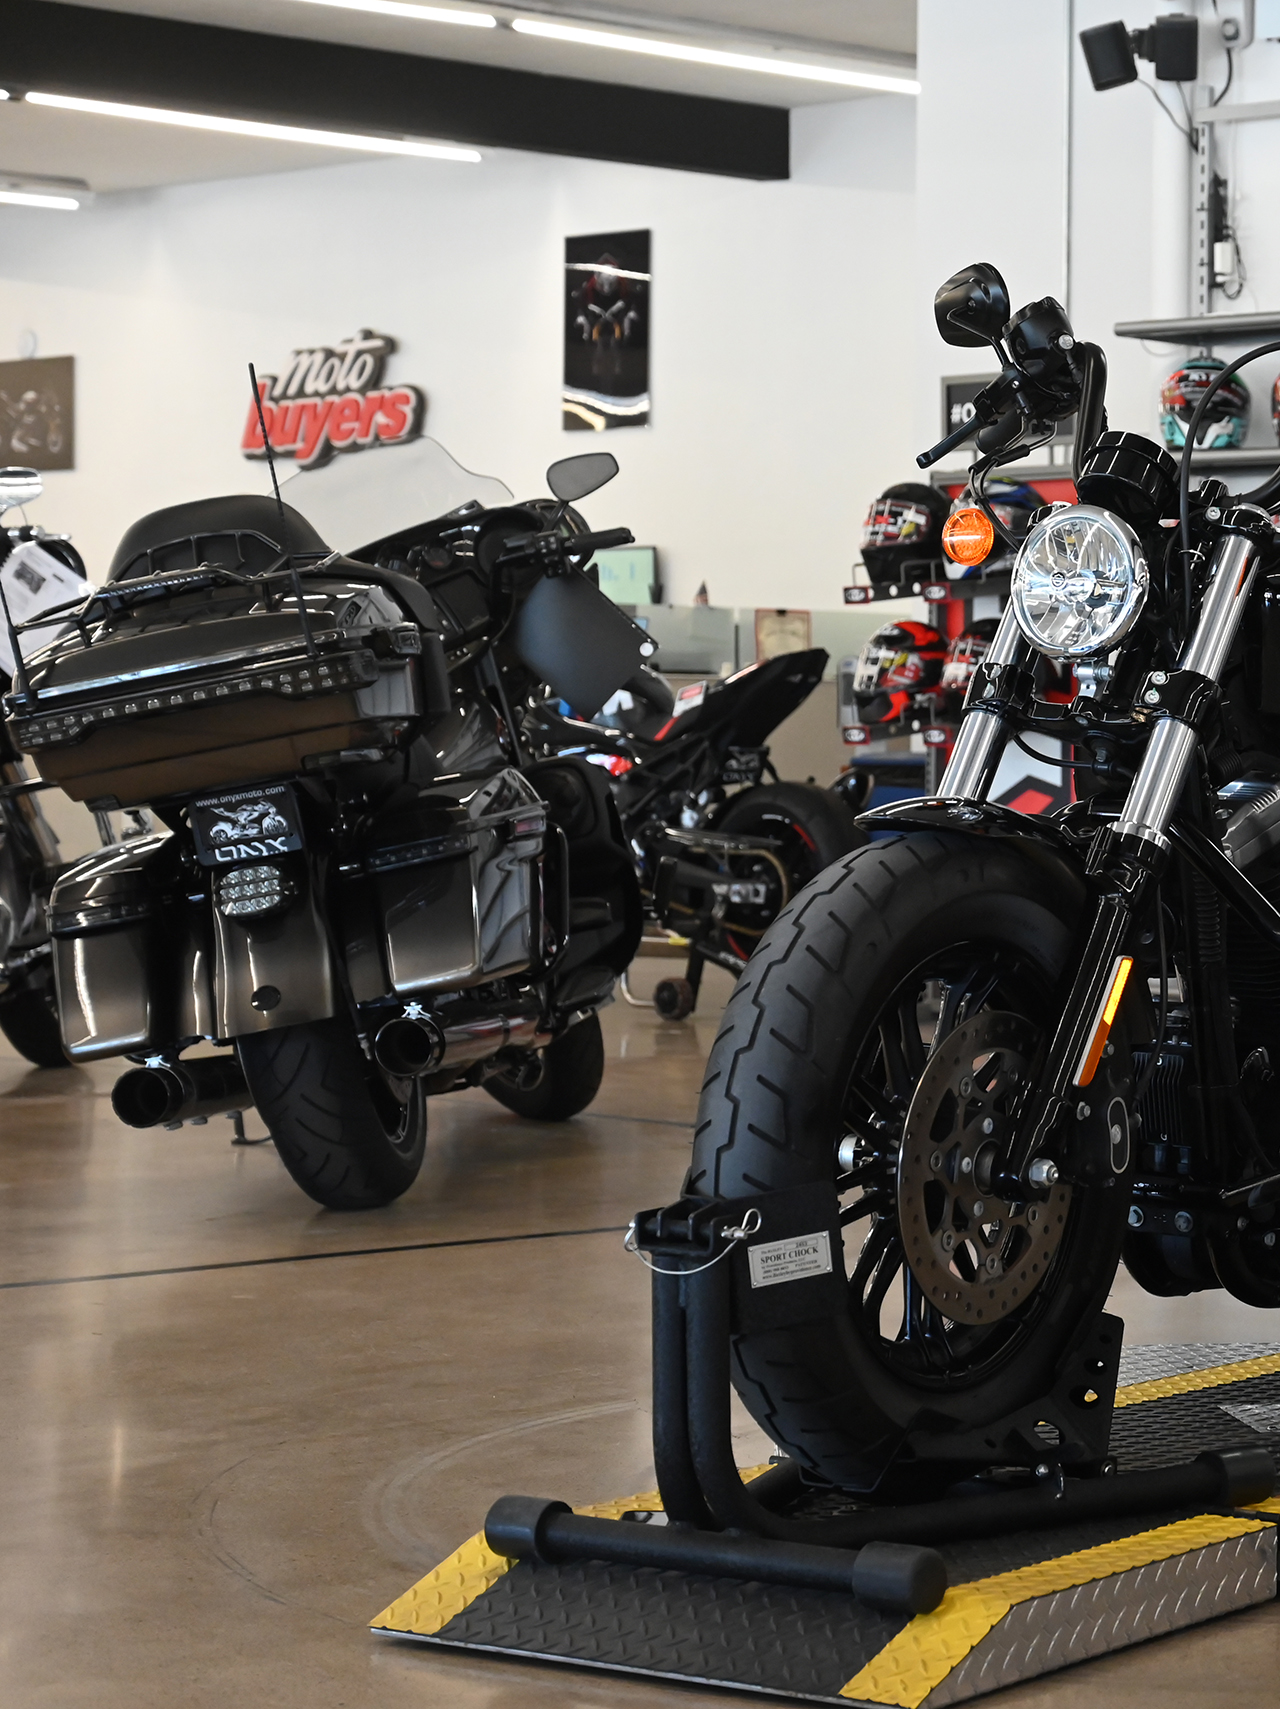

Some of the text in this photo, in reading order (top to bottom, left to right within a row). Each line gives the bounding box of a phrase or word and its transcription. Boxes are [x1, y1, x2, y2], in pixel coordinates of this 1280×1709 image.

[240, 378, 414, 462] buyers
[195, 785, 285, 807] www.onyxmoto.com
[760, 1252, 787, 1265] SPORT
[788, 1246, 819, 1259] CHOCK
